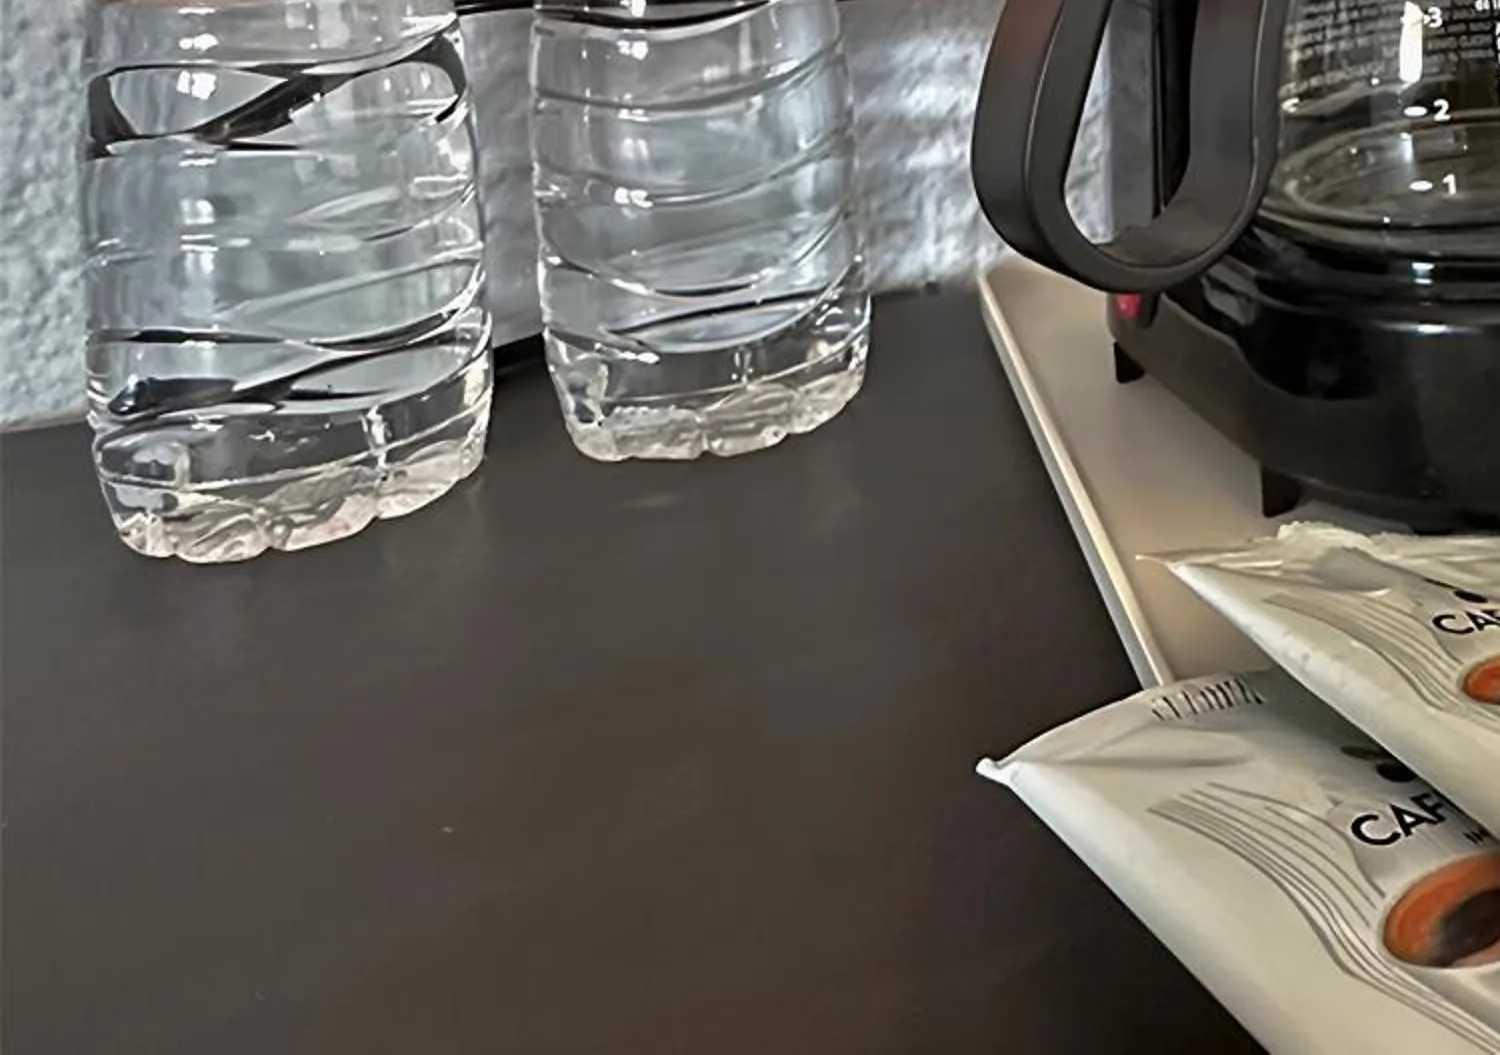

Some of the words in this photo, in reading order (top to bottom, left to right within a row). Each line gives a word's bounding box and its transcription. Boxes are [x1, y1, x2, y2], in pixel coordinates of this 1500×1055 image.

[1427, 6, 1443, 28] 3
[1432, 99, 1451, 122] 2
[1442, 174, 1458, 195] 1
